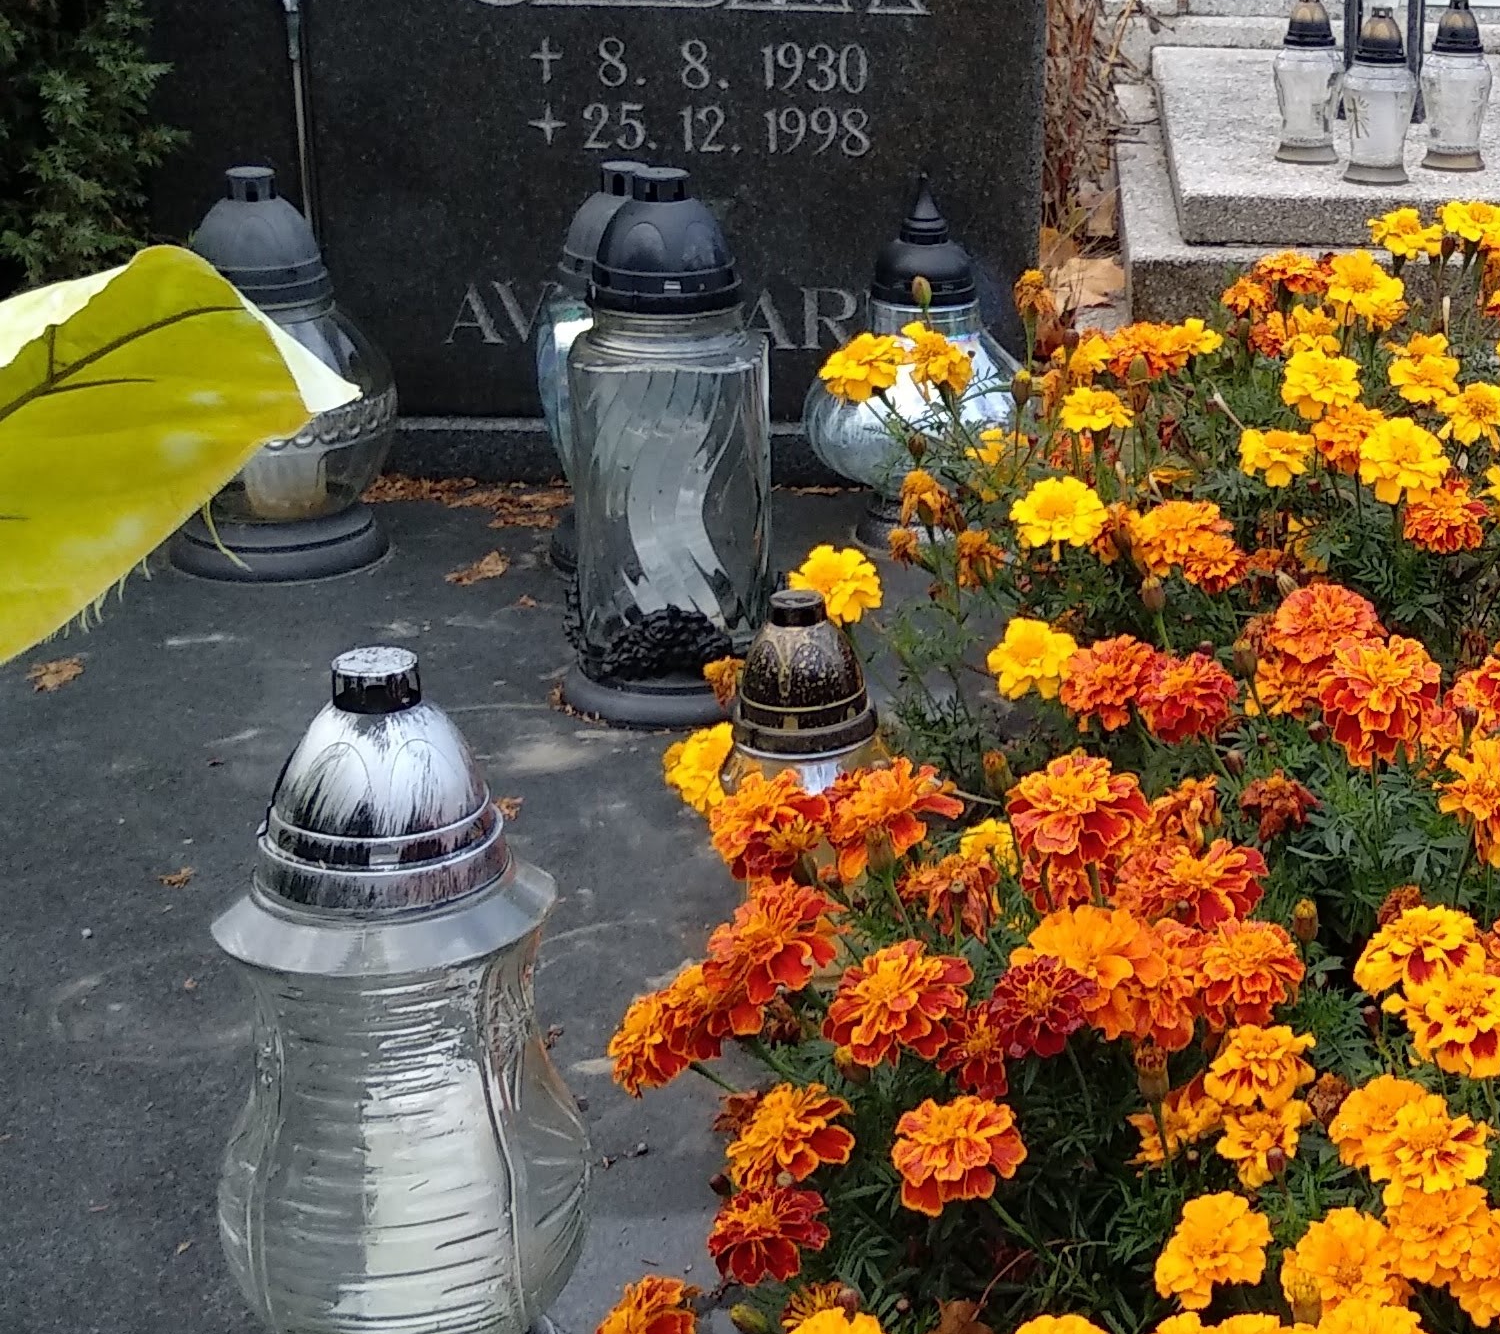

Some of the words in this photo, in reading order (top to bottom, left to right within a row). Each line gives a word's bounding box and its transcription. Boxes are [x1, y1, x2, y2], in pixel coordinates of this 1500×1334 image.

[761, 41, 868, 94] 1930
[583, 103, 657, 150] 25.
[680, 105, 742, 154] 12.
[763, 107, 871, 157] 1998
[444, 280, 557, 345] AV
